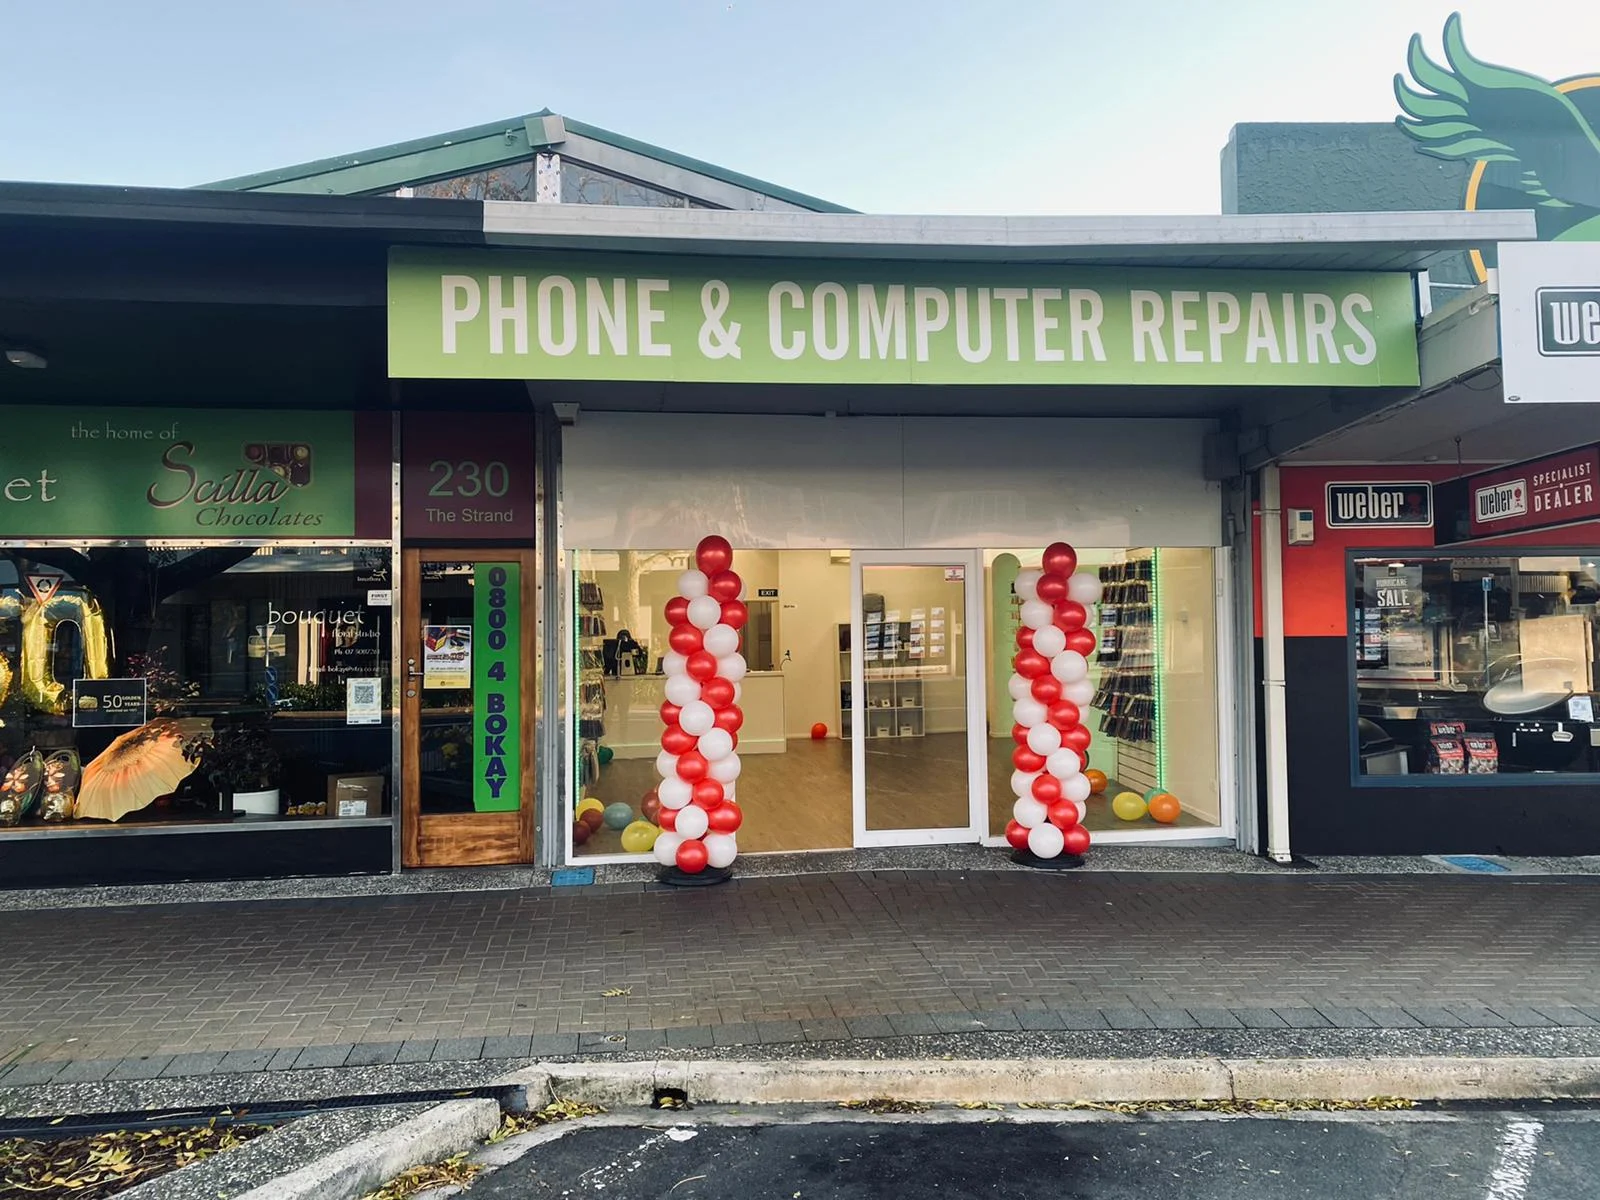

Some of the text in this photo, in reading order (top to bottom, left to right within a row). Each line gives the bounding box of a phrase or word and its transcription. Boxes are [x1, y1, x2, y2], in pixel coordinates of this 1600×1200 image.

[441, 275, 1378, 366] PHONE & COMPUTER REPAIRS
[71, 421, 181, 441] the home of
[4, 469, 57, 502] et
[146, 441, 291, 509] Scilla
[428, 461, 510, 498] 230
[1533, 462, 1592, 486] SPECIALIST
[1336, 487, 1404, 519] weber
[1480, 487, 1513, 516] weber
[1534, 485, 1593, 513] DEALER
[195, 507, 323, 527] Chocolates
[425, 508, 514, 523] The Strand
[1377, 588, 1411, 607] SALE
[268, 602, 366, 638] bouquet
[484, 566, 508, 799] 0800 4 BOKAY
[102, 694, 122, 708] 50
